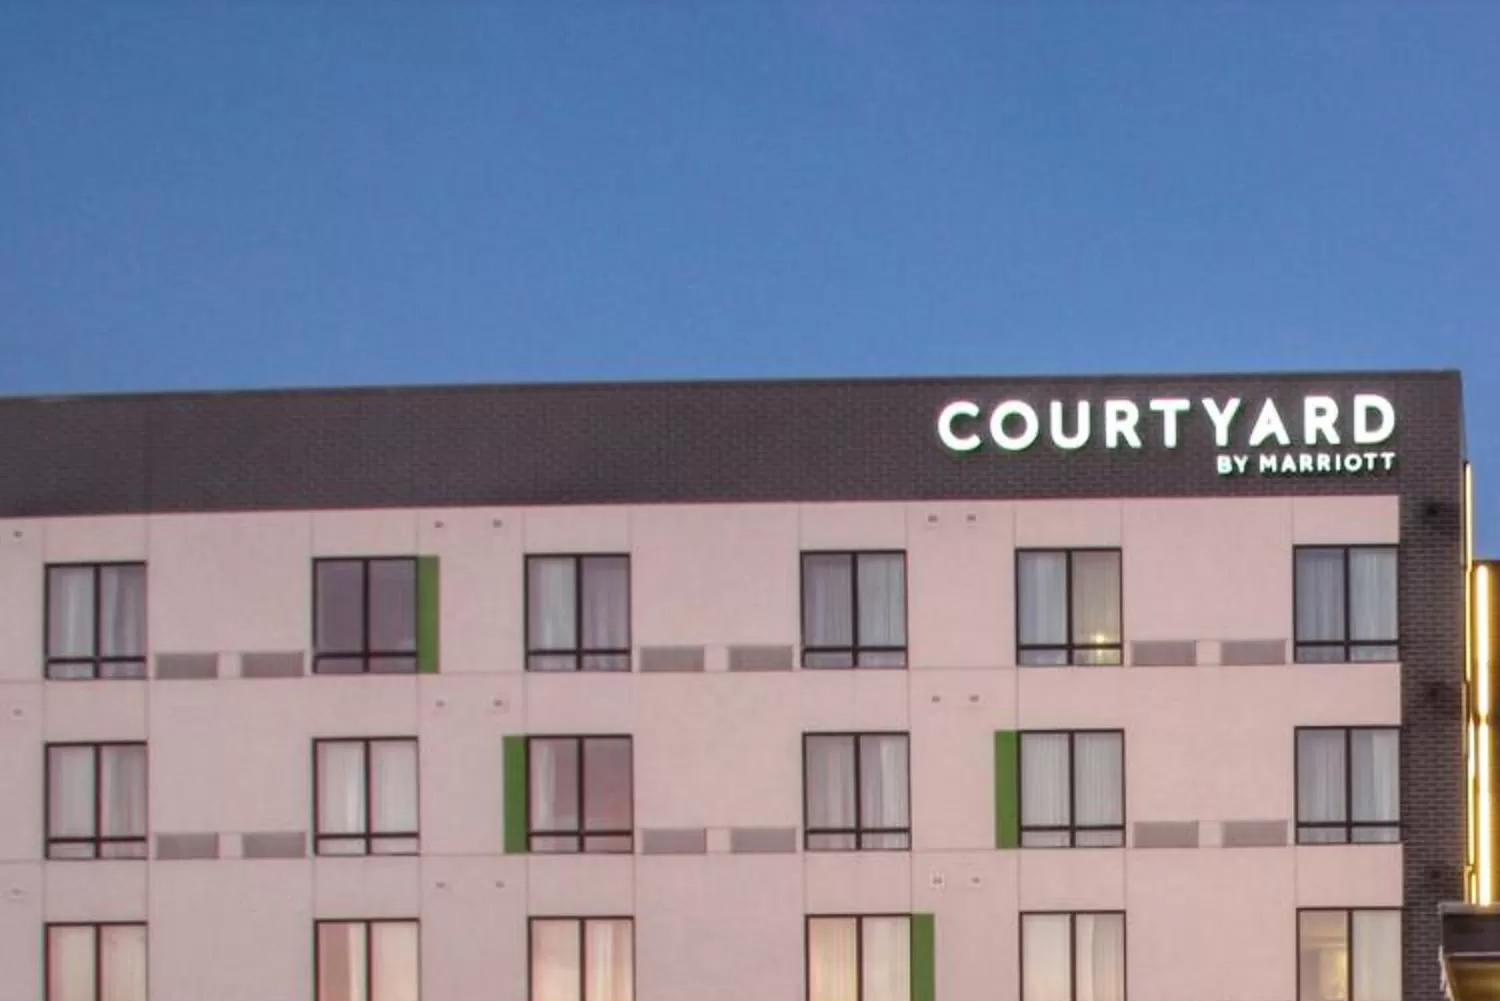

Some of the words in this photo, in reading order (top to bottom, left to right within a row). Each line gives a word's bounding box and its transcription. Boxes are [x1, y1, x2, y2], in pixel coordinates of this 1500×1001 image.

[937, 394, 1396, 451] COURTYARD
[1216, 454, 1249, 475] BY
[1259, 452, 1396, 473] MARRIOTT
